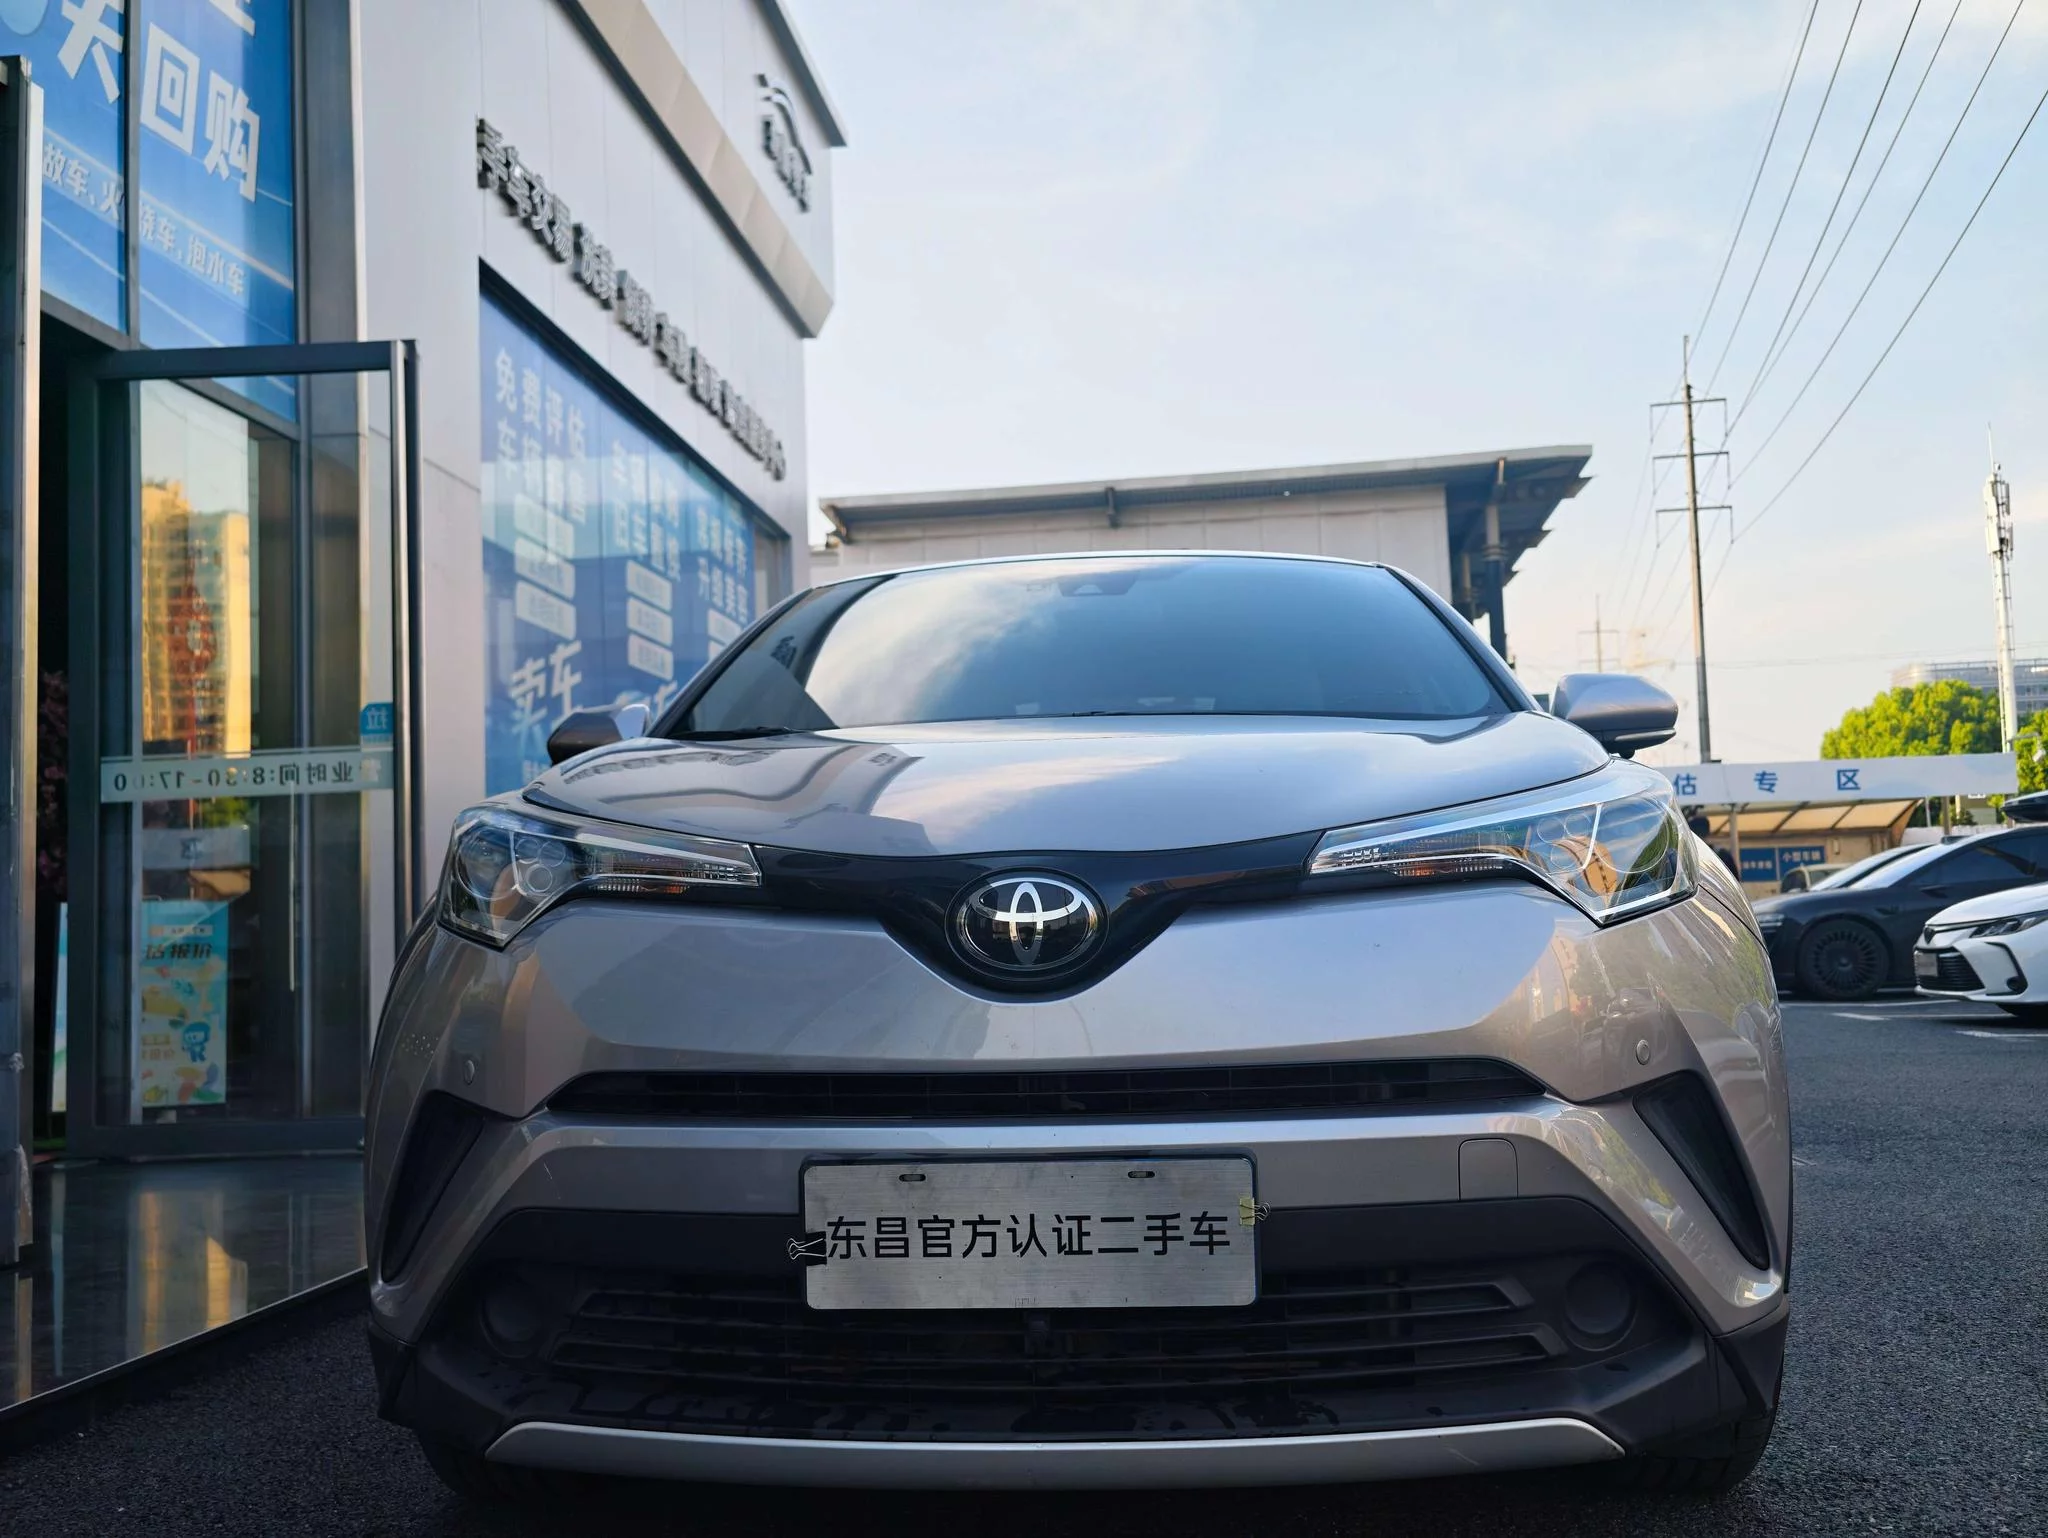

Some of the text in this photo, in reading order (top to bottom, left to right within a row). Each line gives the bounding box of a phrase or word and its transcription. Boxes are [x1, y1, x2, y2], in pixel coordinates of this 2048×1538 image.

[827, 1211, 1231, 1260] 东昌官方认证二手车
